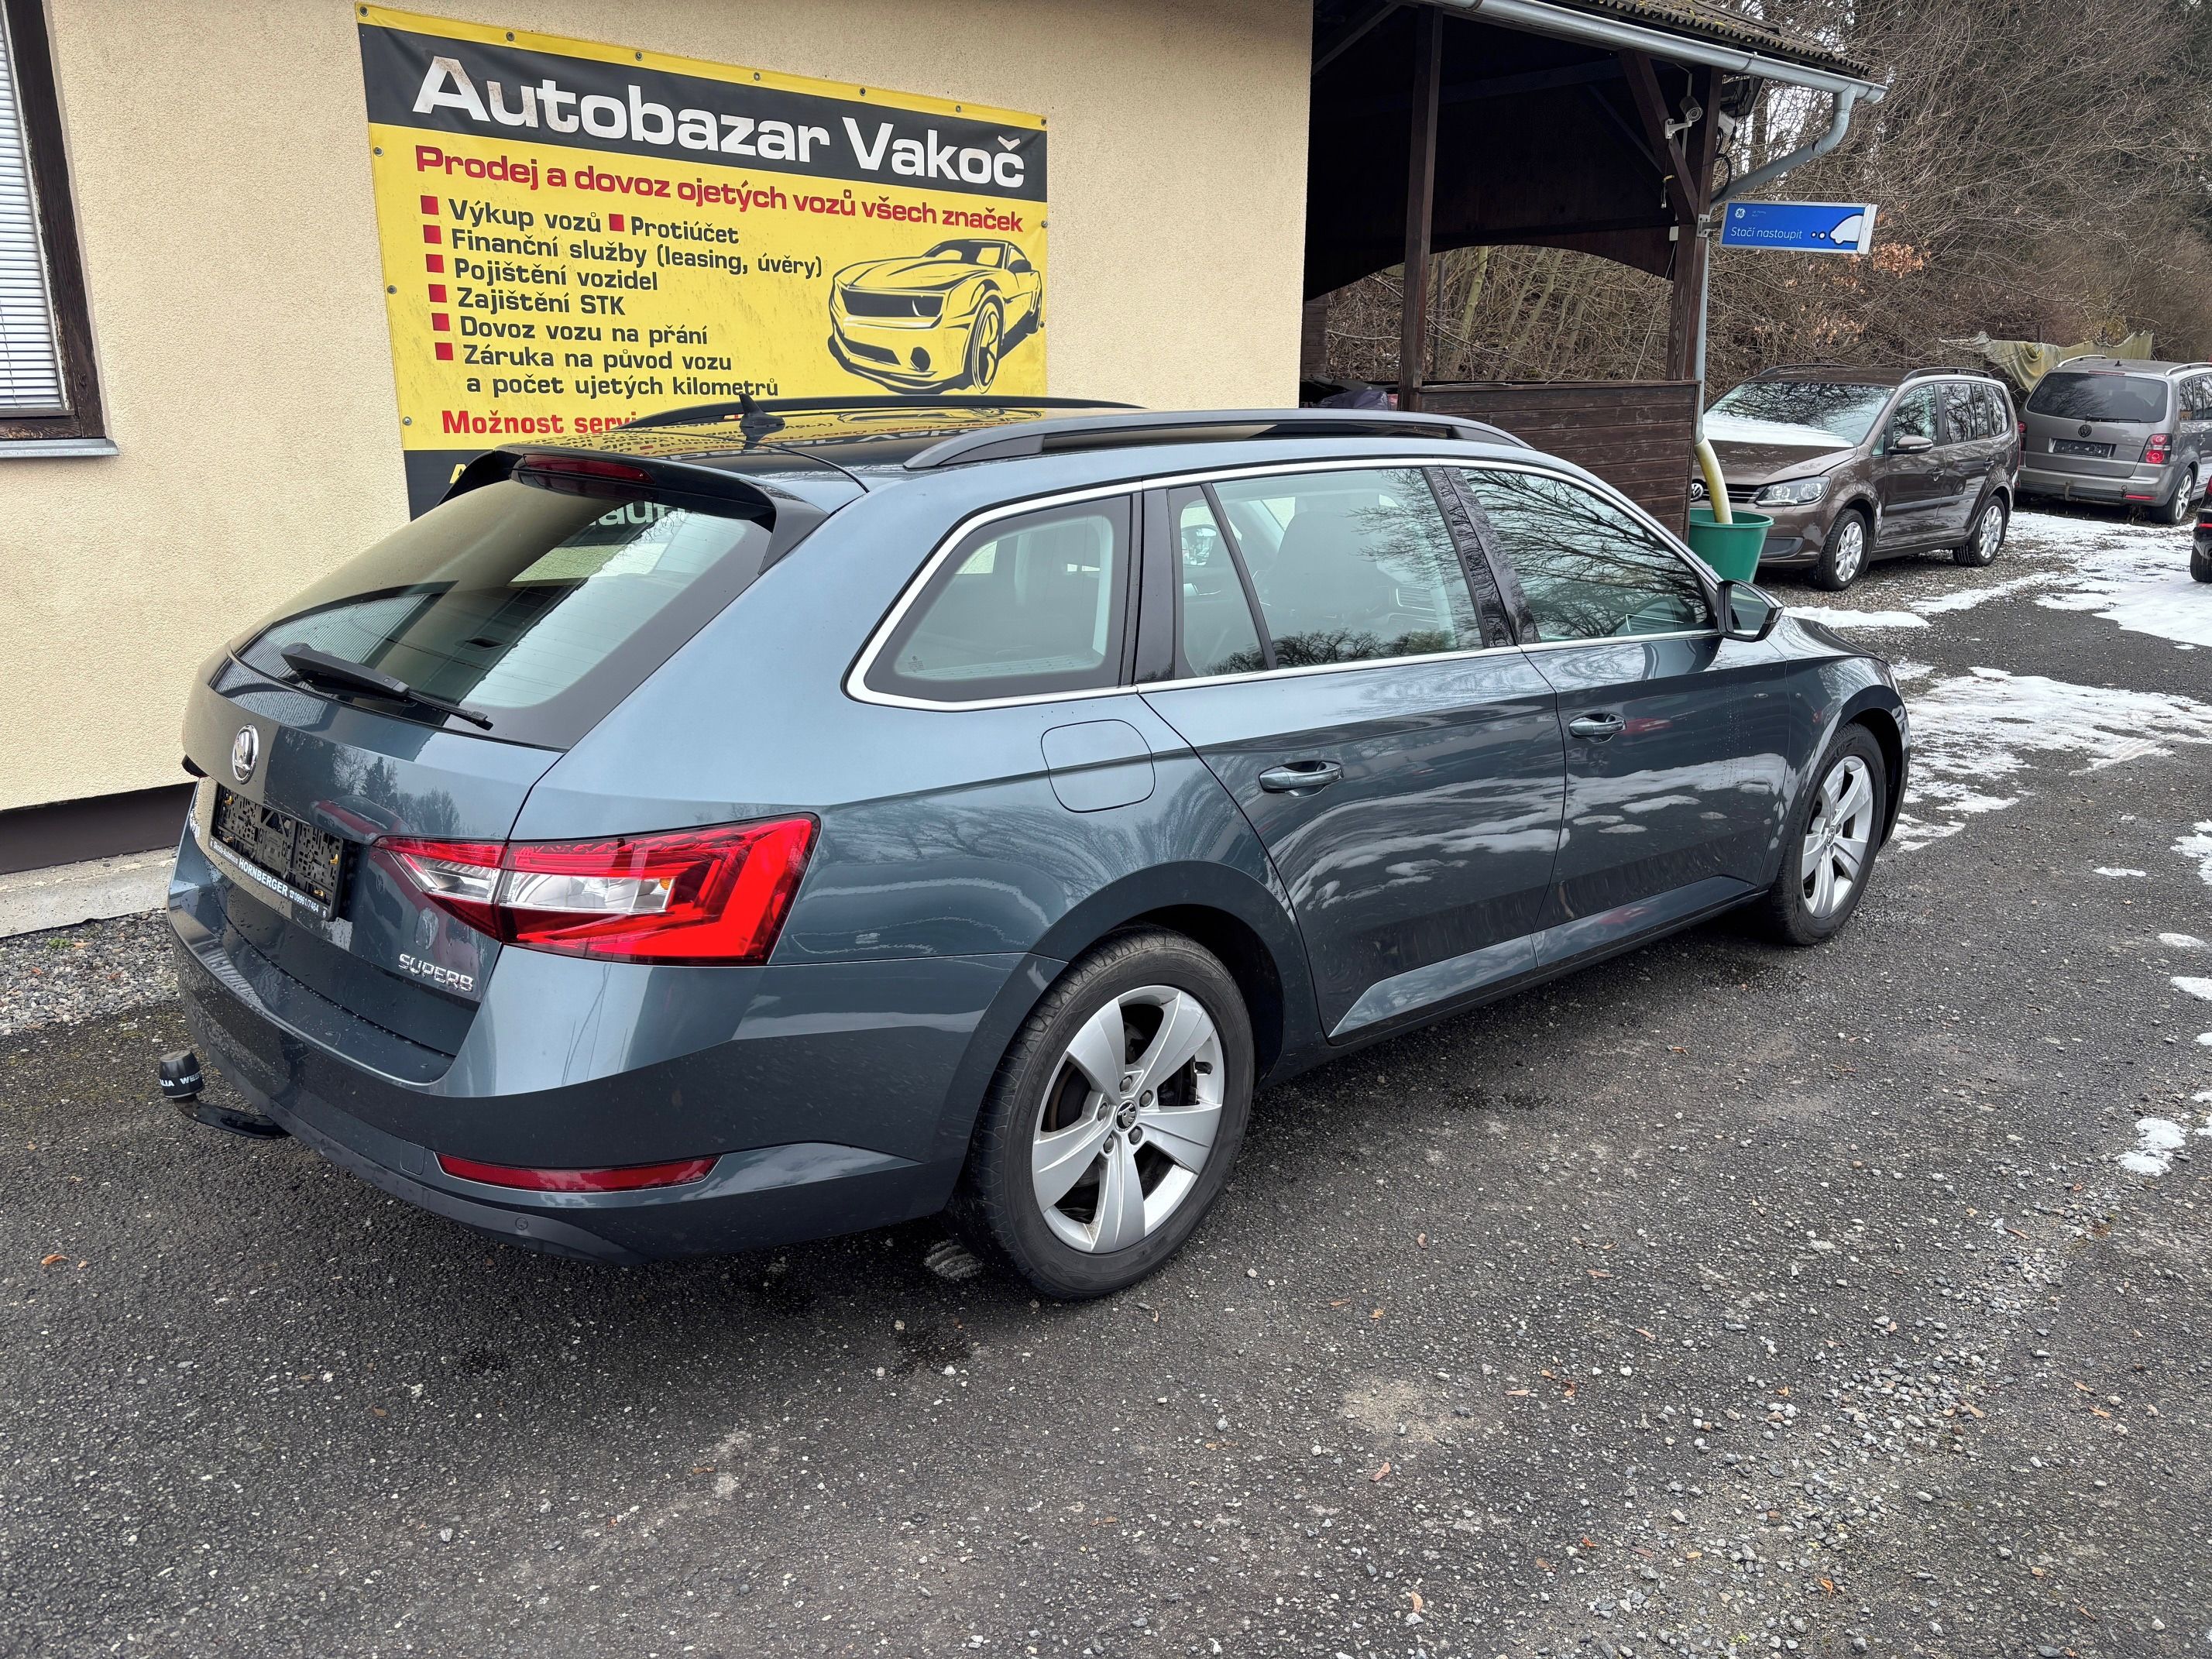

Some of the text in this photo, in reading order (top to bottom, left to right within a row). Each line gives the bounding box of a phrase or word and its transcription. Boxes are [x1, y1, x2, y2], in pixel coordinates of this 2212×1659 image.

[413, 56, 1025, 188] Autobazar Vakoč
[415, 145, 1023, 232] Prodej a dovoz ojetých vozů všech značek
[448, 198, 601, 233] Výkup vozů
[631, 216, 739, 244] Protiúčet
[1731, 226, 1803, 240] Stačí nastoupit
[452, 228, 822, 279] Finanční služby (leasing, úvěry)
[455, 258, 658, 290] Pojištění vozidel
[458, 287, 626, 316] Zajištění STK
[461, 317, 708, 348] Dovoz vozu na přání
[464, 345, 732, 376] Záruka na původ vozu
[466, 373, 778, 400] a počet ujetých kilometrů
[442, 410, 565, 434] Možnost
[239, 857, 288, 897] HORNBERGER
[398, 953, 473, 991] SUPERB
